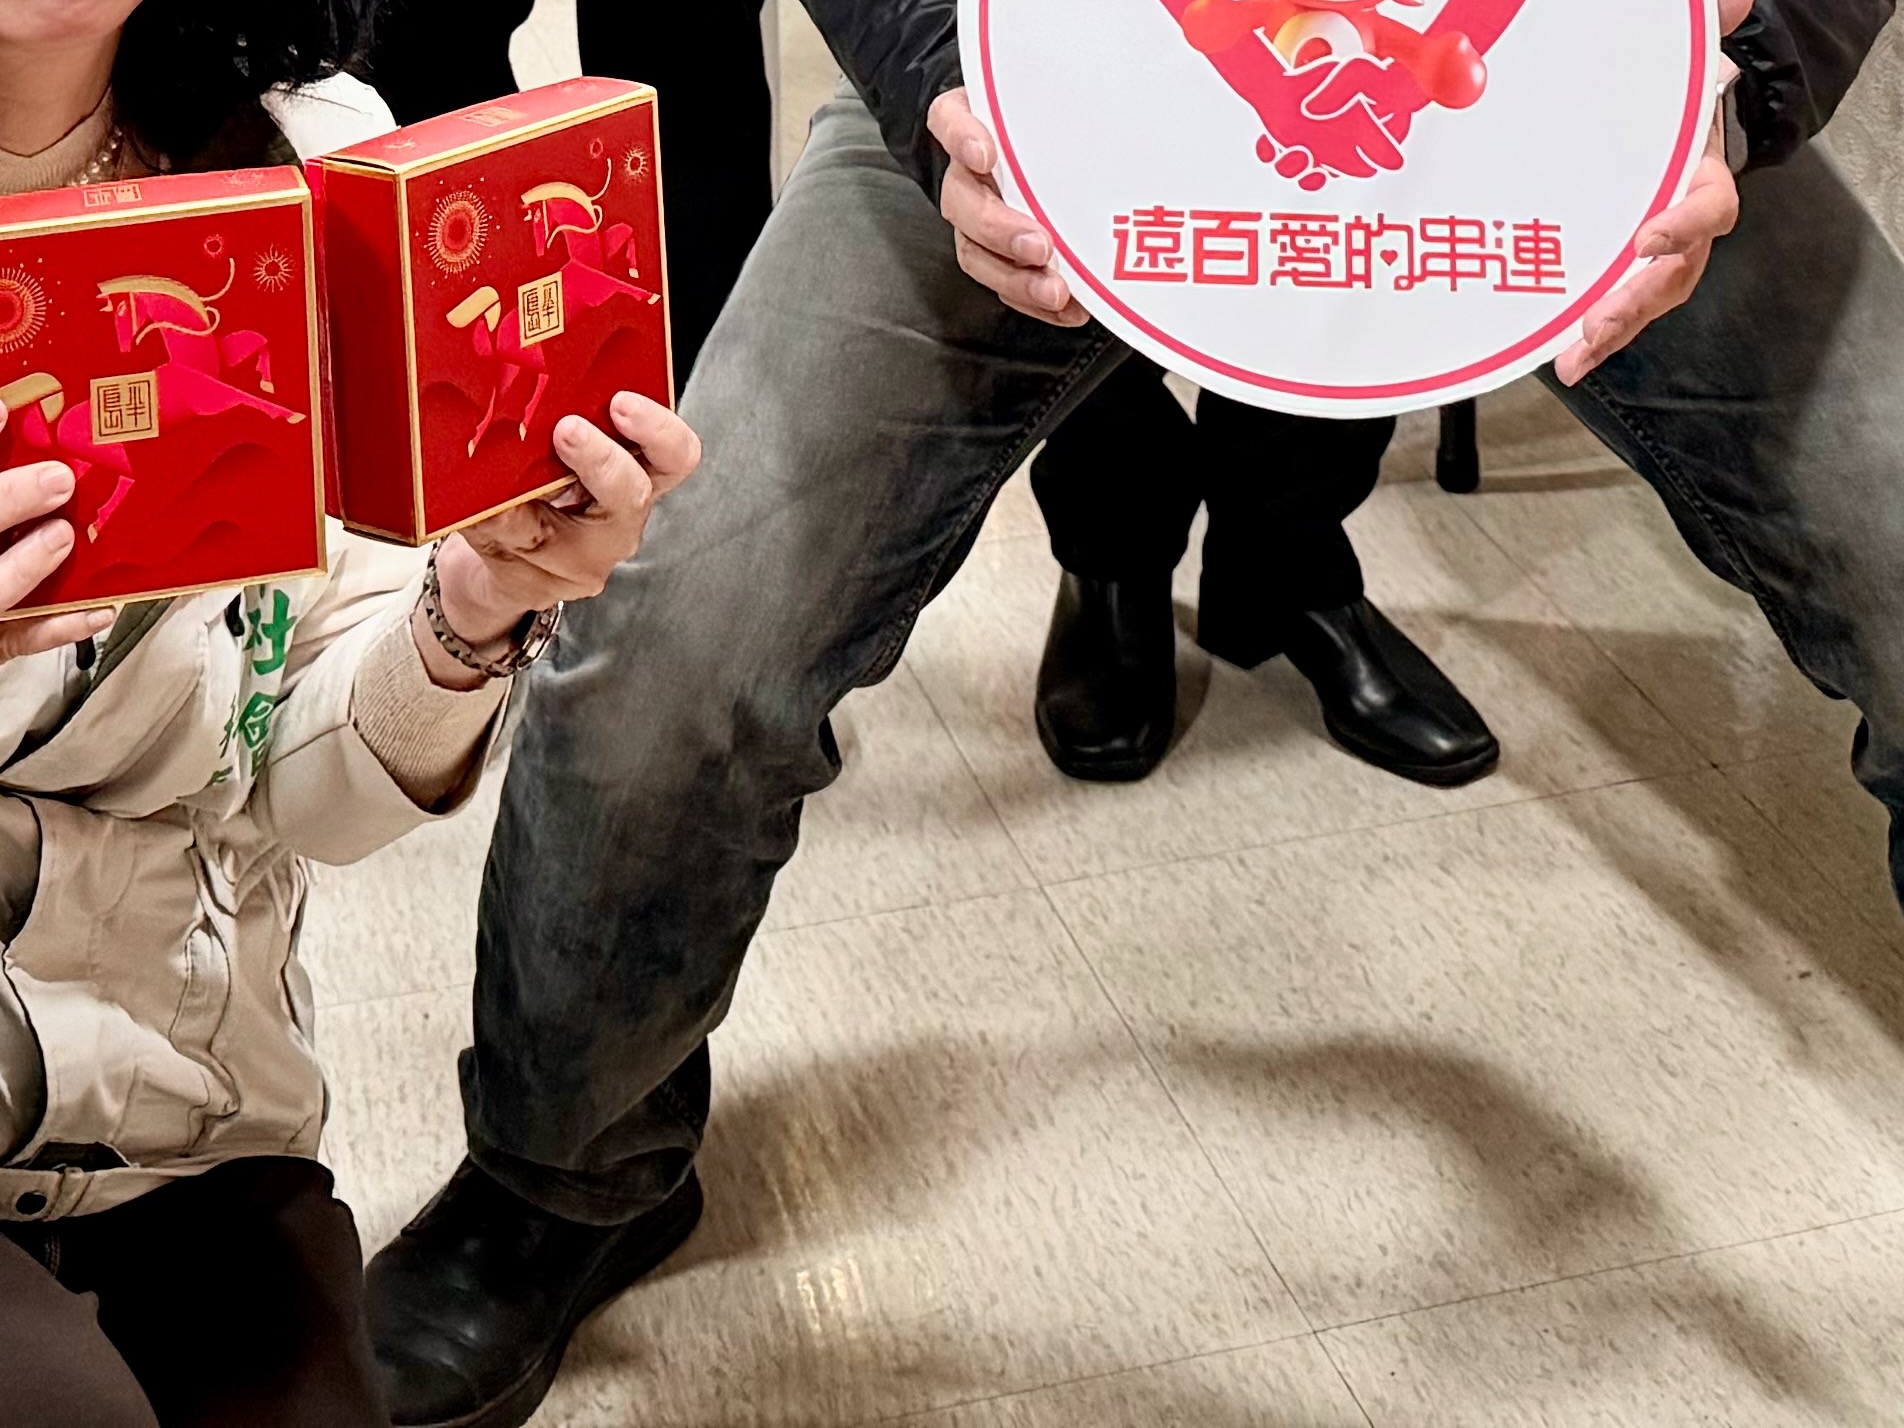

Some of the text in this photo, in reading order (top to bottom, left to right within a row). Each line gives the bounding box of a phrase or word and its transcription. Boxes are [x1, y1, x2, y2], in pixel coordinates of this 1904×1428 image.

[1112, 204, 1566, 294] 遠百愛的串連
